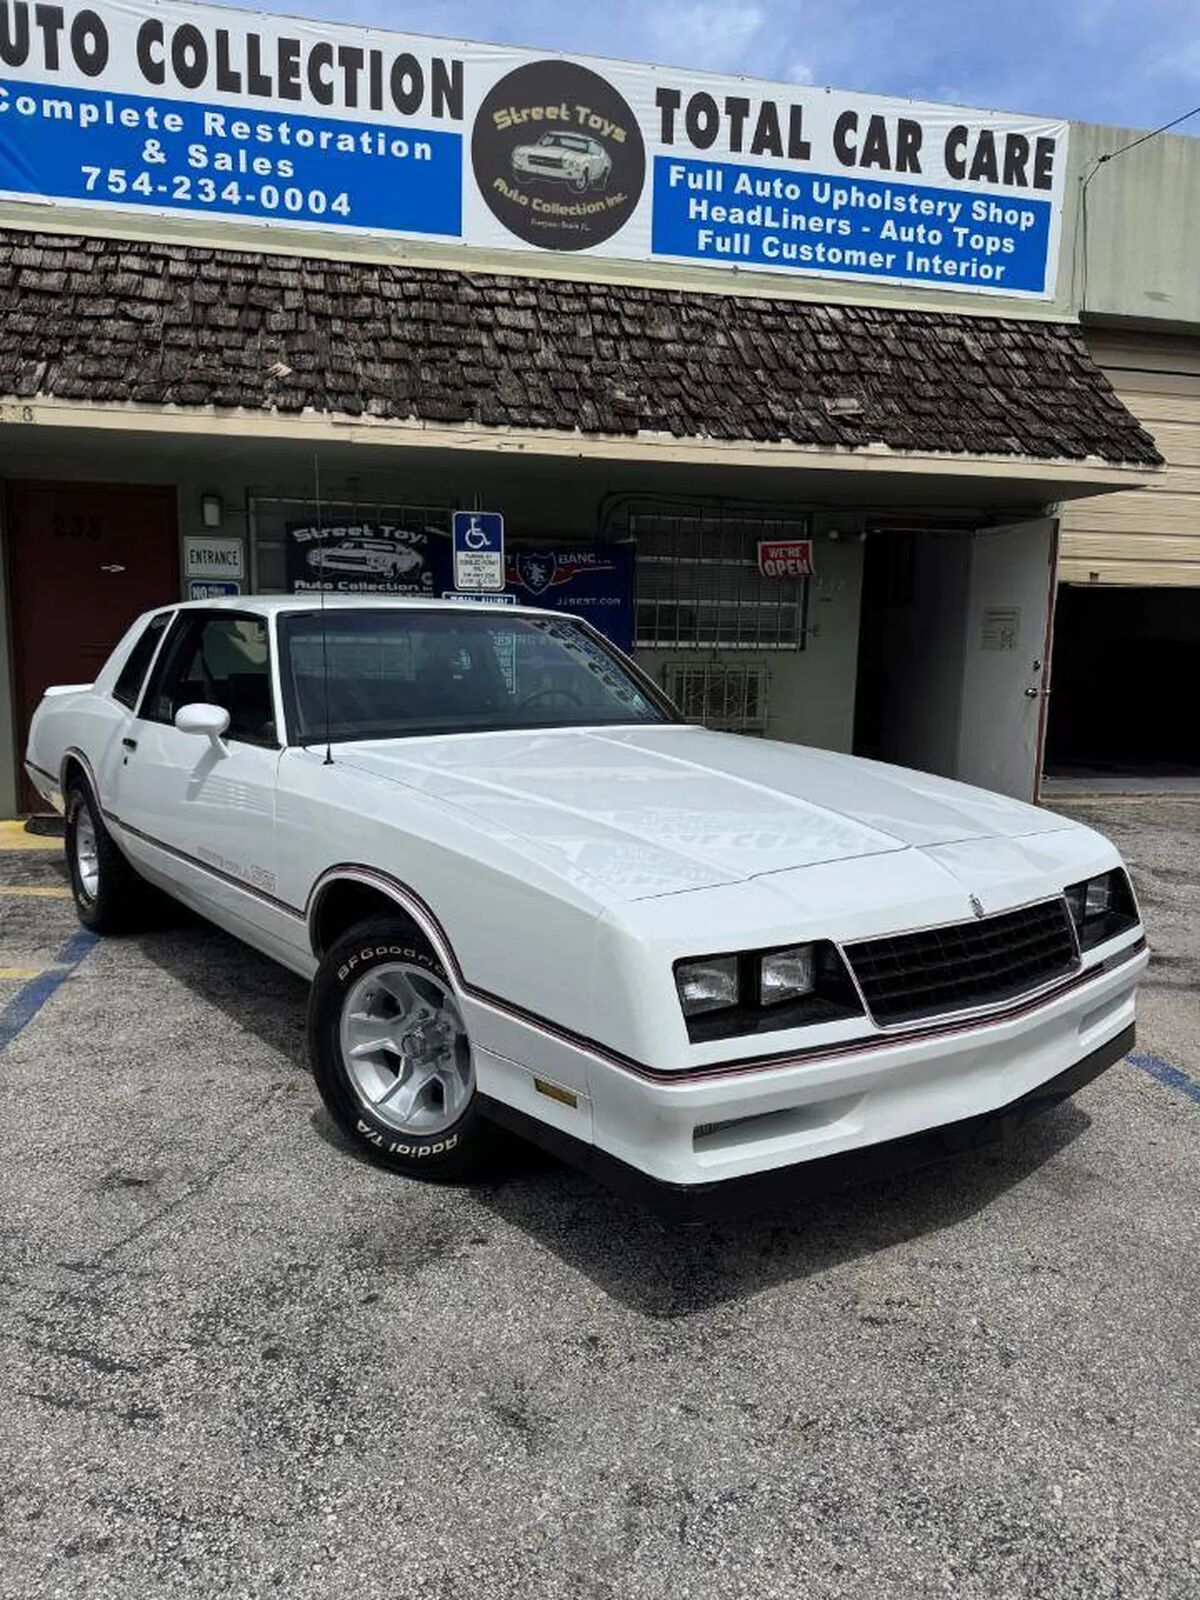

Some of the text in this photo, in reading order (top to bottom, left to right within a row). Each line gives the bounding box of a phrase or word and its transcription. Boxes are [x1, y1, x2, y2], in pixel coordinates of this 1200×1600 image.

[136, 18, 464, 120] COLLECTION
[203, 111, 432, 160] Restoration
[492, 102, 628, 144] Street Toys
[655, 87, 1055, 190] TOTAL CAR CARE
[142, 138, 295, 178] & Sales
[80, 165, 351, 216] 754-234-0004
[492, 177, 529, 207] Auto
[532, 197, 606, 217] Collection
[668, 165, 1035, 231] Full Auto Upholstery Shop
[688, 197, 851, 235] HeadLiners
[879, 219, 943, 246] Auto
[953, 226, 1015, 255] Tops
[696, 229, 1006, 281] Full Customer Interior
[292, 523, 375, 543] Street
[189, 549, 239, 567] ENTRANCE
[763, 558, 811, 577] OPEN
[294, 579, 335, 591] Auto
[337, 580, 419, 593] Collection
[356, 1119, 384, 1146] T/A
